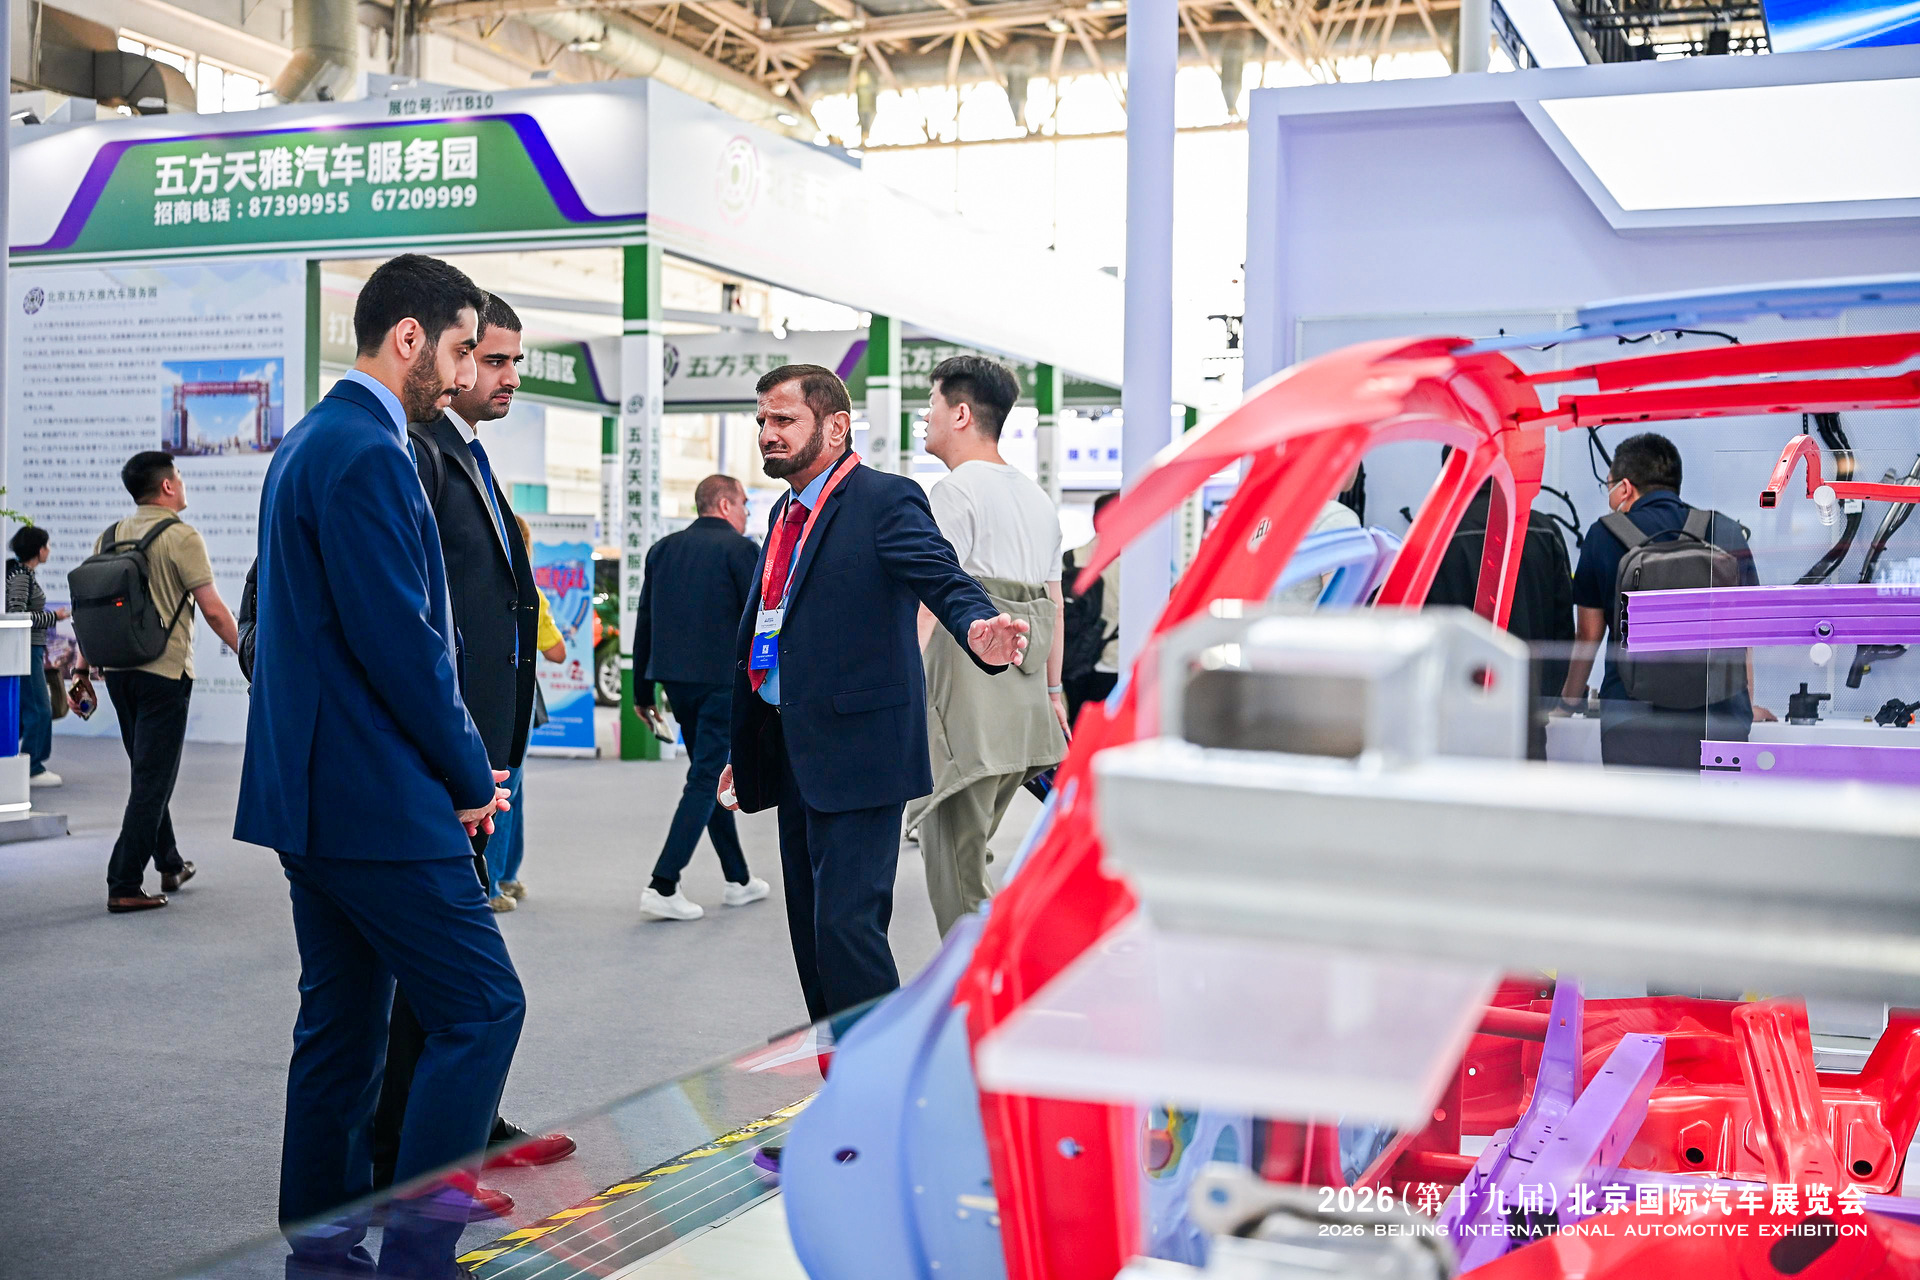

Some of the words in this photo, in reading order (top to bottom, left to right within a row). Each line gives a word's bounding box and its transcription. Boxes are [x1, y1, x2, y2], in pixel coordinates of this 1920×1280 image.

[153, 136, 479, 197] 五方天雅汽车服务园
[371, 184, 478, 212] 67209999
[47, 286, 158, 305] 北京五方天雅汽车服务园
